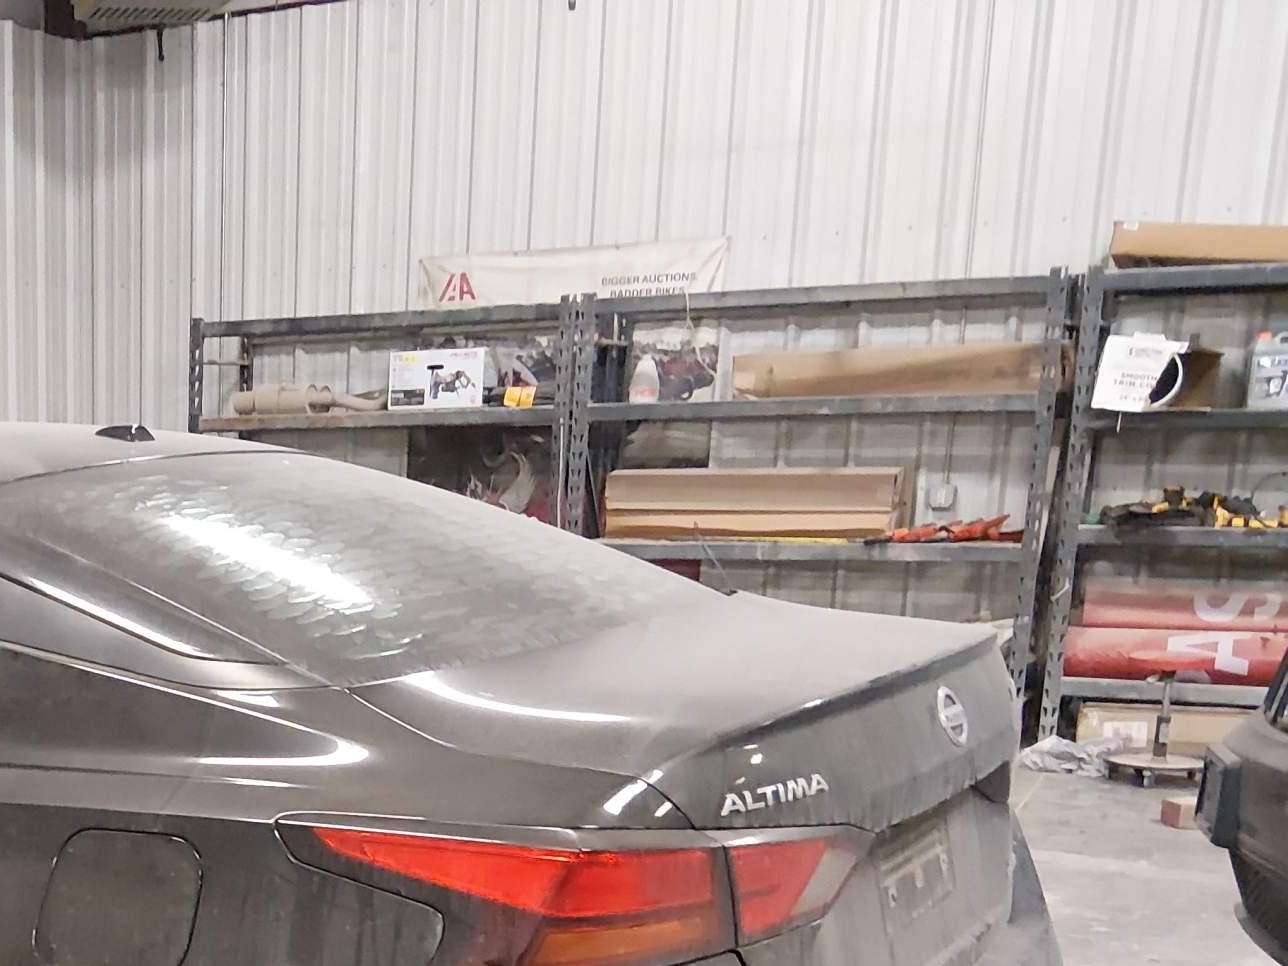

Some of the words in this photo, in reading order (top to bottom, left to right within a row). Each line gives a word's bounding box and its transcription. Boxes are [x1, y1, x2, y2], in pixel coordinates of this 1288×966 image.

[601, 275, 640, 286] BIGGER
[642, 272, 697, 283] AUCTIONS
[721, 774, 829, 816] ALTIMA
